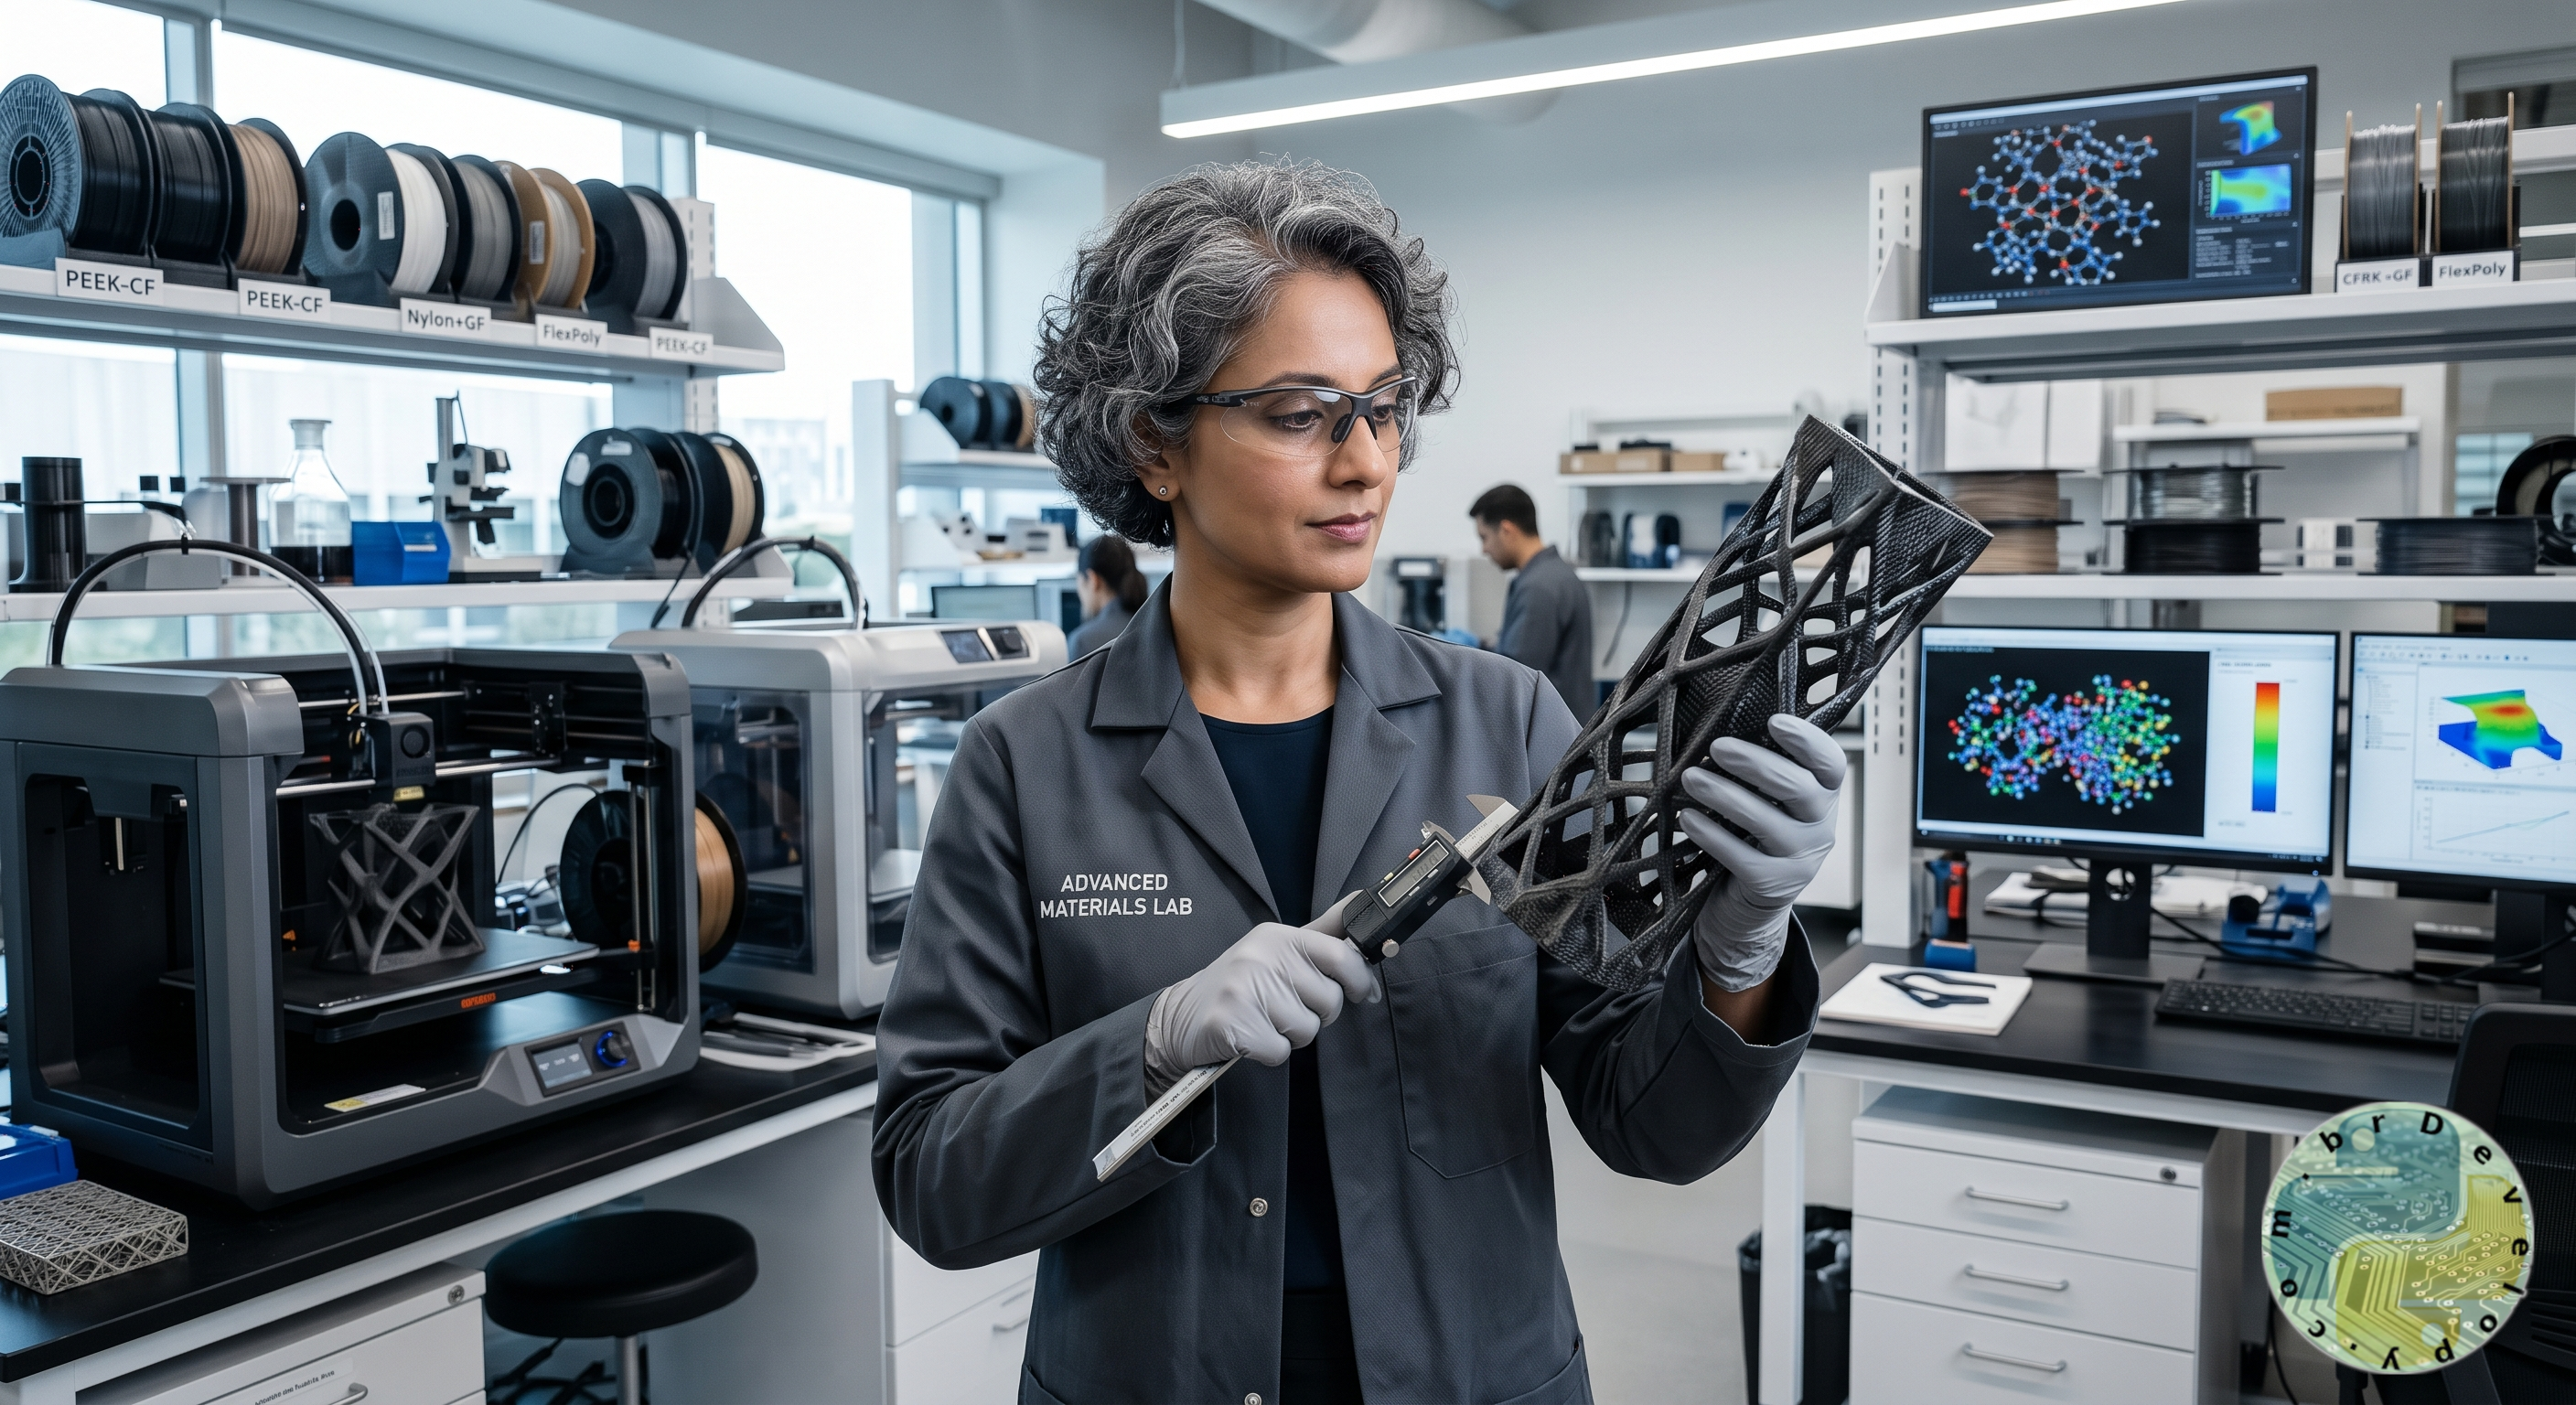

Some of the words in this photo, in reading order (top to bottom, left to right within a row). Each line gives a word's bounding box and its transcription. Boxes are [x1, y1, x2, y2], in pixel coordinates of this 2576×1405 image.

[2439, 262, 2506, 278] FlexPoly
[66, 269, 155, 295] PEEK-CF
[247, 290, 323, 313] PEEK-CF
[407, 308, 486, 331] Nylon+GF
[543, 324, 601, 348] FlexPoly
[1060, 874, 1168, 892] ADVANCED
[1040, 897, 1147, 918] MATERIALS
[1154, 897, 1193, 916] LAB
